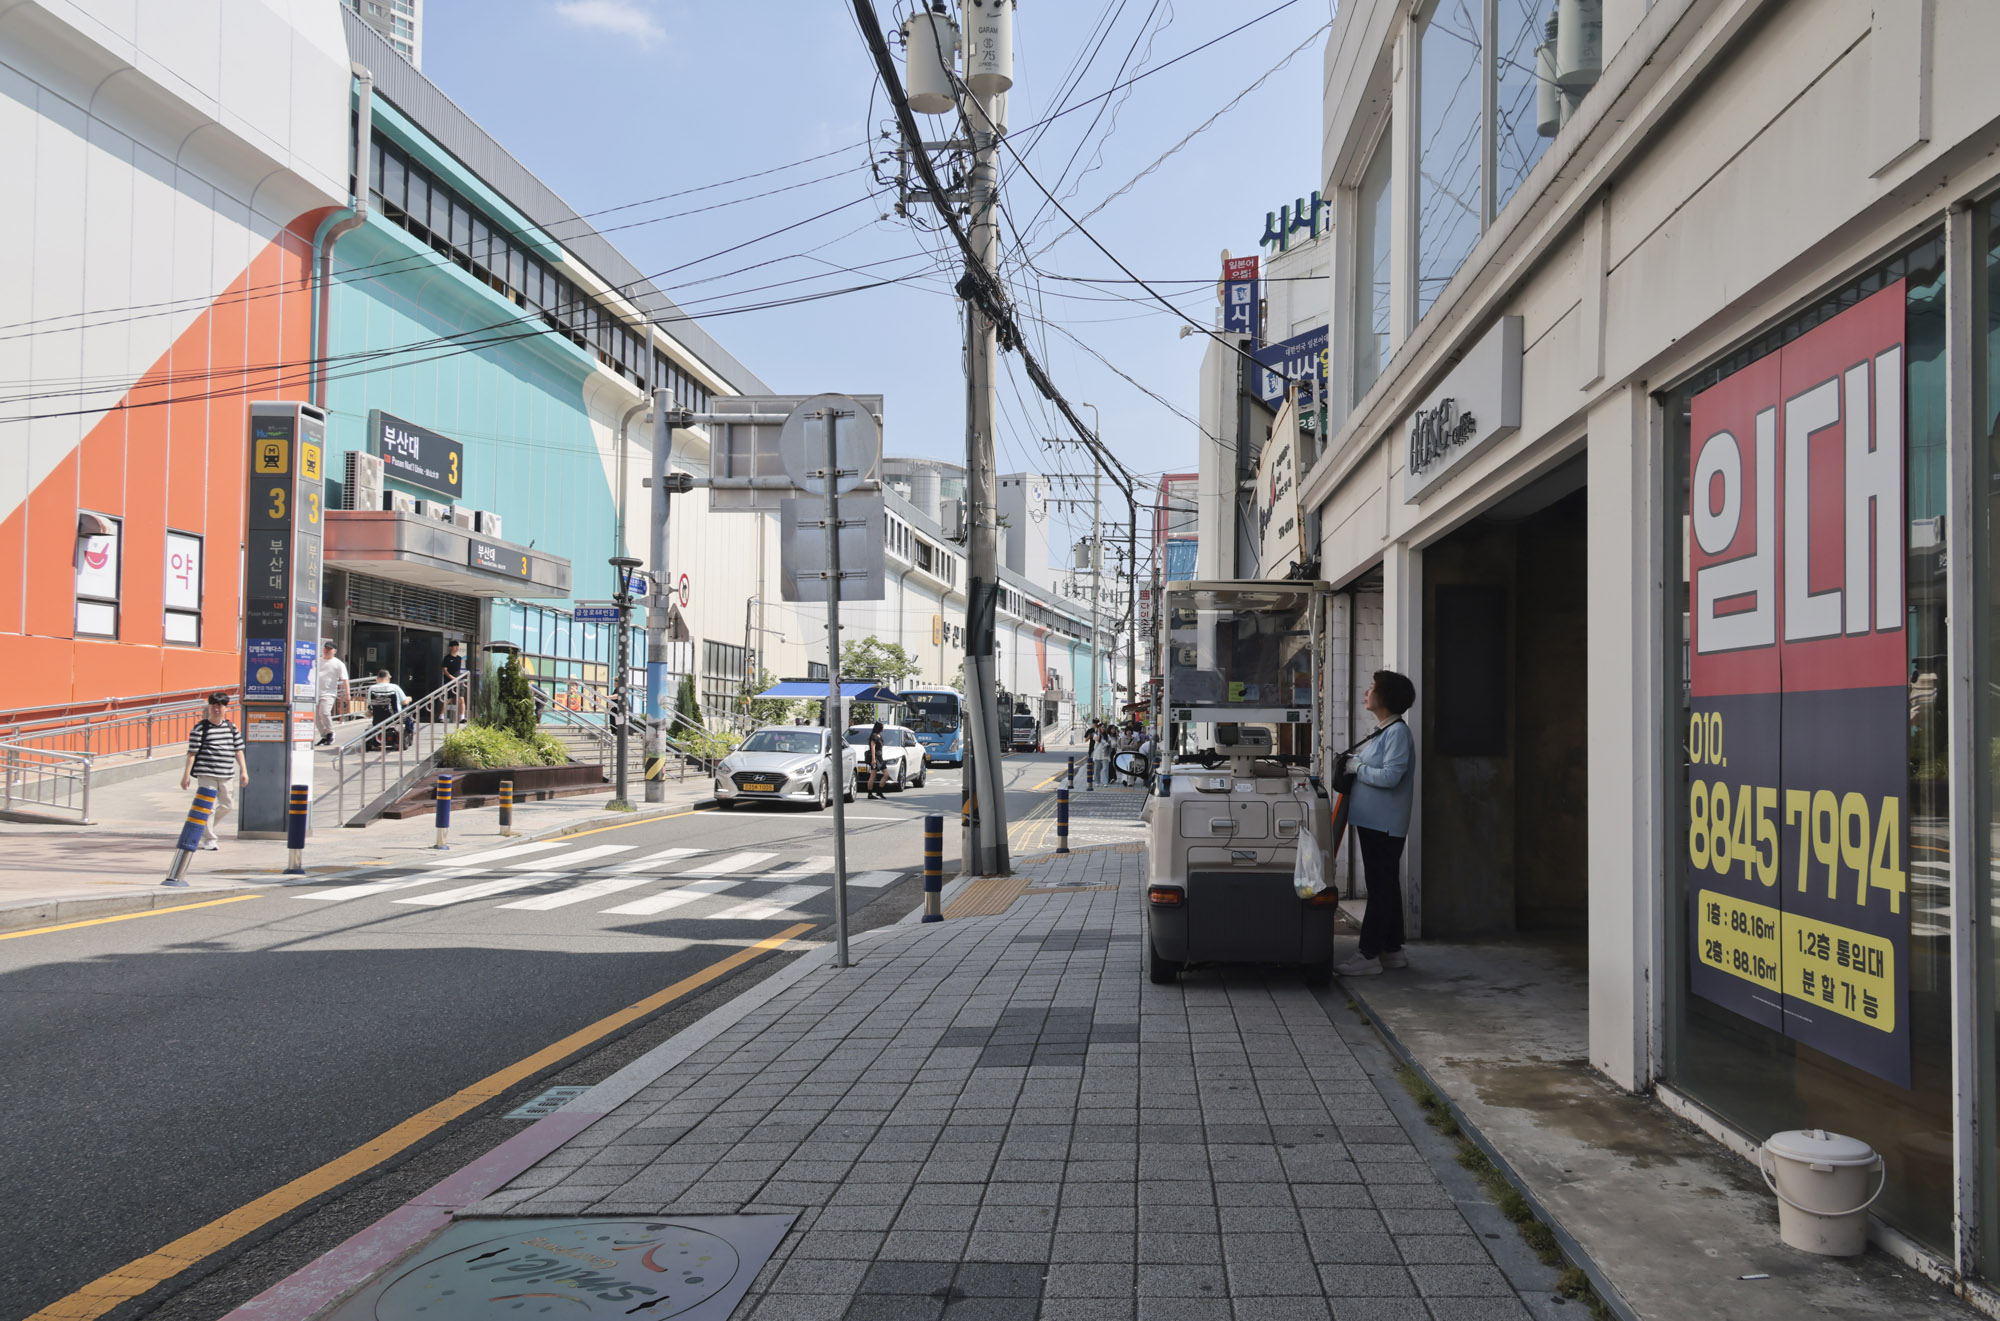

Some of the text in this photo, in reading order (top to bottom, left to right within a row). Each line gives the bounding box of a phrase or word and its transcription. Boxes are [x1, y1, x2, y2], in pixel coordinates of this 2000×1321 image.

[978, 26, 998, 34] GARAM
[982, 50, 996, 61] 75
[1259, 190, 1332, 252] 시사
[1229, 258, 1254, 270] 일본어
[383, 425, 419, 461] 부산대
[448, 451, 458, 485] 3
[268, 487, 286, 519] 3
[308, 493, 319, 524] 3
[1692, 342, 1903, 656] 임대
[269, 539, 284, 590] 부산대
[307, 544, 317, 594] 부산대
[477, 545, 496, 562] 부산대
[521, 556, 527, 575] 3
[171, 553, 193, 590] 약
[928, 695, 933, 703] 7
[1690, 711, 1727, 768] 010.
[1689, 779, 1906, 914] 8845 7994
[1707, 902, 1721, 926] 1층
[1705, 939, 1723, 964] 2층
[1798, 929, 1884, 979] 1.2층 통임대
